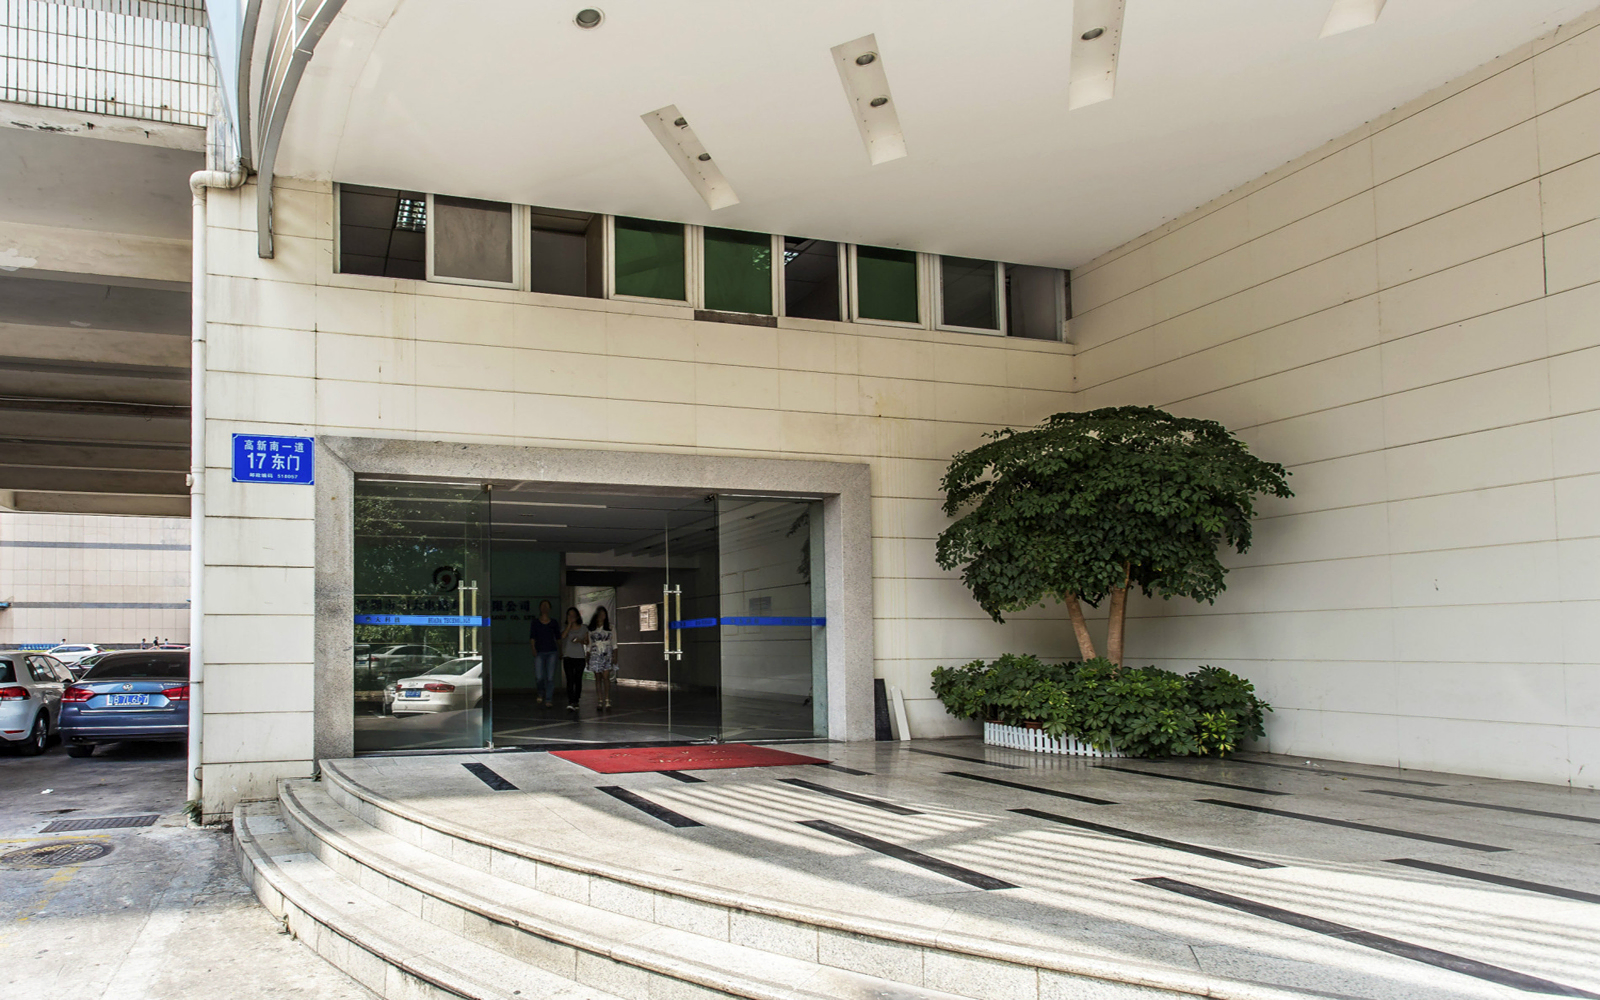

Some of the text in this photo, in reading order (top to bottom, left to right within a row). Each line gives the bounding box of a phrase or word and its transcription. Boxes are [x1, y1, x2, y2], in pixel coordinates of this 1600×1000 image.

[244, 439, 305, 453] 高新南一道
